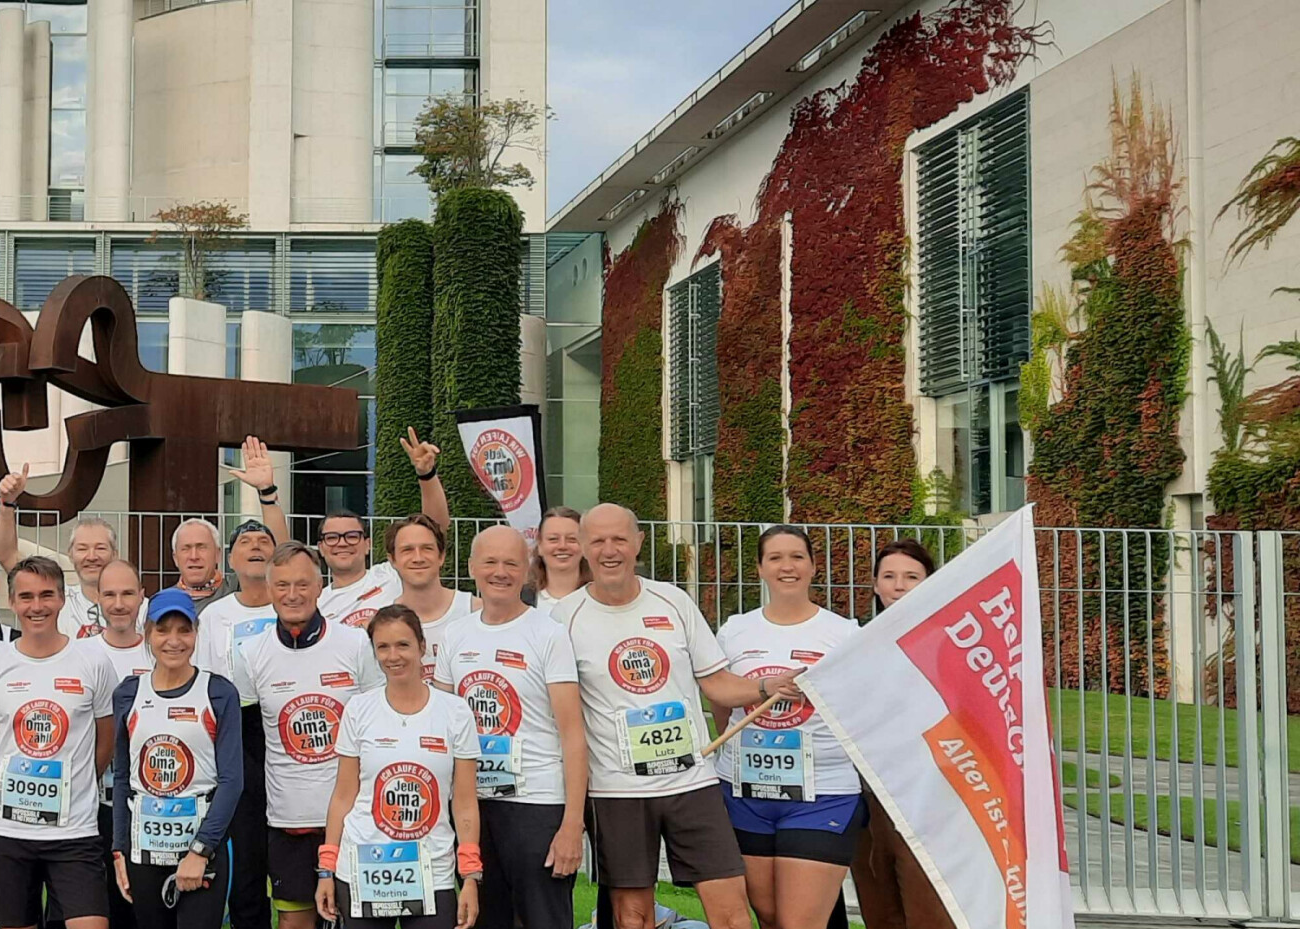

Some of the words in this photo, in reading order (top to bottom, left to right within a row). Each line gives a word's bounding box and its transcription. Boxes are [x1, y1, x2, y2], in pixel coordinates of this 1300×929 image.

[622, 657, 650, 671] Oma
[462, 675, 474, 688] ICH
[473, 673, 496, 682] LAUFE
[473, 687, 498, 700] Jede
[284, 702, 297, 715] ICH
[296, 695, 319, 706] LAUFE
[32, 713, 52, 721] Jede
[299, 710, 326, 722] Jede
[474, 714, 500, 728] ählt
[26, 719, 51, 732] Oma
[292, 720, 328, 736] Oma
[300, 732, 333, 749] zählt
[640, 726, 683, 746] 4822
[155, 747, 175, 757] Jede
[655, 748, 676, 757] Lutz
[149, 756, 175, 769] Oma
[745, 753, 795, 770] 19919
[152, 770, 177, 783] zählt
[380, 770, 392, 782] ICH
[392, 764, 418, 774] LAUFE
[758, 772, 782, 782] Carin
[6, 778, 58, 798] 30909
[394, 780, 420, 792] Jede
[938, 738, 990, 793] Alter
[983, 797, 1008, 832] ist
[18, 797, 43, 808] Sören
[385, 790, 420, 808] Oma
[391, 807, 422, 822] zählt
[144, 821, 194, 836] 63934
[149, 839, 189, 850] Hildegard
[363, 868, 416, 885] 16942
[373, 890, 408, 898] Martina
